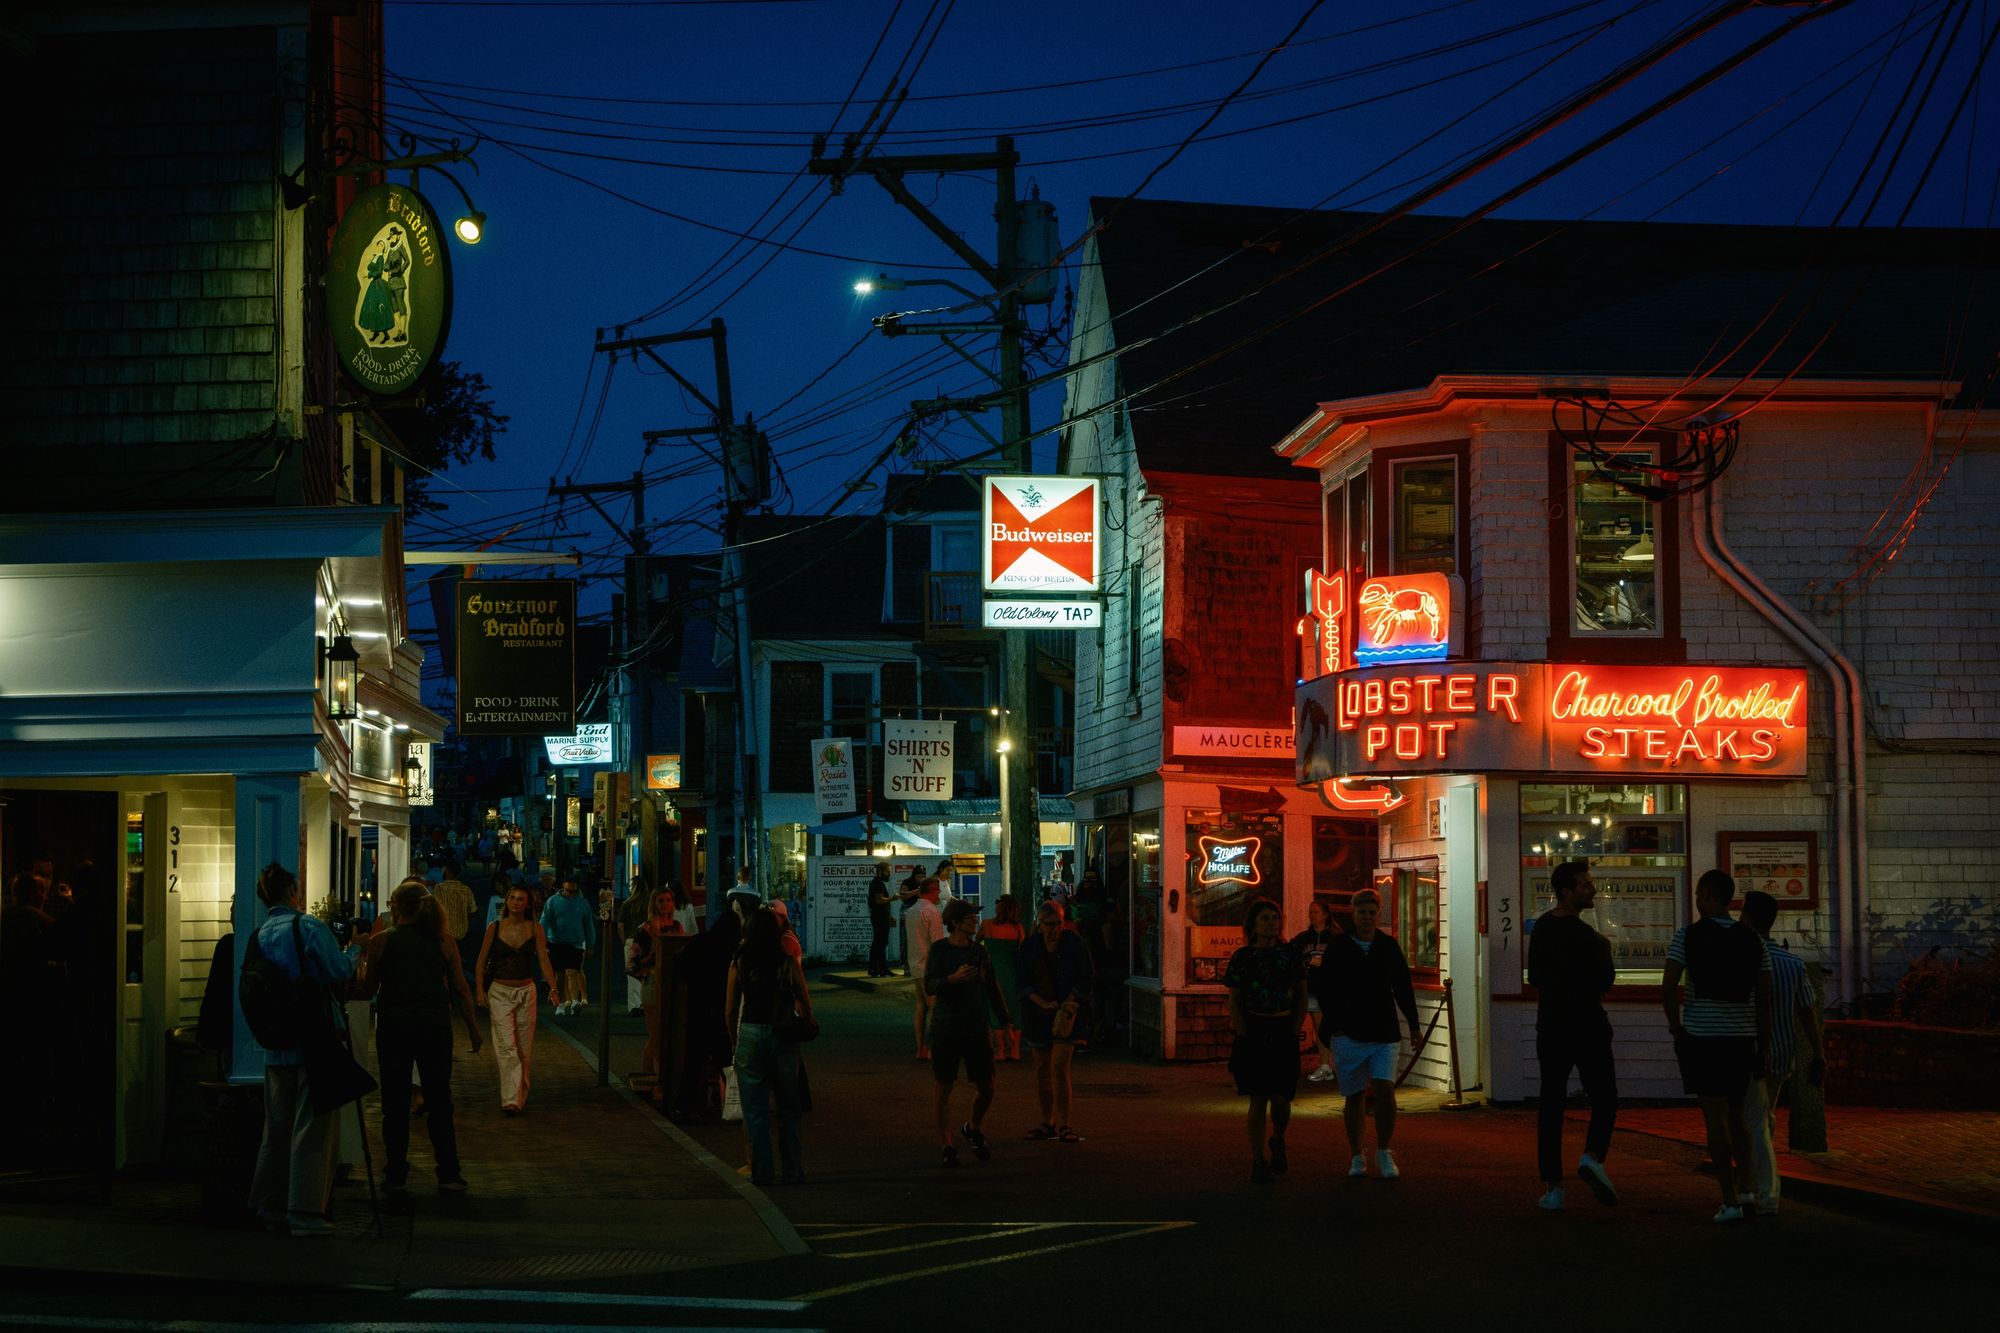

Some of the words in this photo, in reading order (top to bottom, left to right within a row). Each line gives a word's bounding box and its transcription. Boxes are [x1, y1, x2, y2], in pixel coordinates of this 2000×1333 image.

[387, 191, 434, 266] Bradford
[357, 347, 382, 372] FOOD
[389, 344, 418, 372] DRINK
[352, 351, 422, 385] ENTERTAINMENT
[1044, 575, 1075, 583] BEERS
[466, 593, 559, 616] Governor
[993, 607, 1018, 620] Old
[1017, 607, 1059, 623] Colony
[1063, 607, 1093, 621] TAP
[482, 616, 566, 637] Bradford
[503, 639, 564, 648] RESTAURANT
[474, 697, 512, 708] FOOD
[519, 697, 560, 708] DRINK
[1337, 673, 1522, 731] LOBSTER
[1552, 671, 1694, 728] Charcoal
[465, 712, 569, 723] ENTERTAINMENT
[584, 725, 609, 736] End
[579, 736, 609, 744] SUPPLY
[887, 739, 950, 757] SHIRTS
[1200, 731, 1293, 749] MAUCLÈRE
[1367, 721, 1457, 762] POT
[1580, 727, 1781, 762] STEAKS
[818, 783, 850, 791] AUTHENTIC
[891, 776, 947, 792] STUFF
[1212, 845, 1248, 863] Miller
[823, 866, 849, 875] RENT
[1208, 861, 1230, 873] HIGH
[1230, 864, 1251, 874] LIFE
[1626, 882, 1673, 893] DINING
[1209, 937, 1242, 945] MAUC
[1653, 945, 1667, 956] DA
